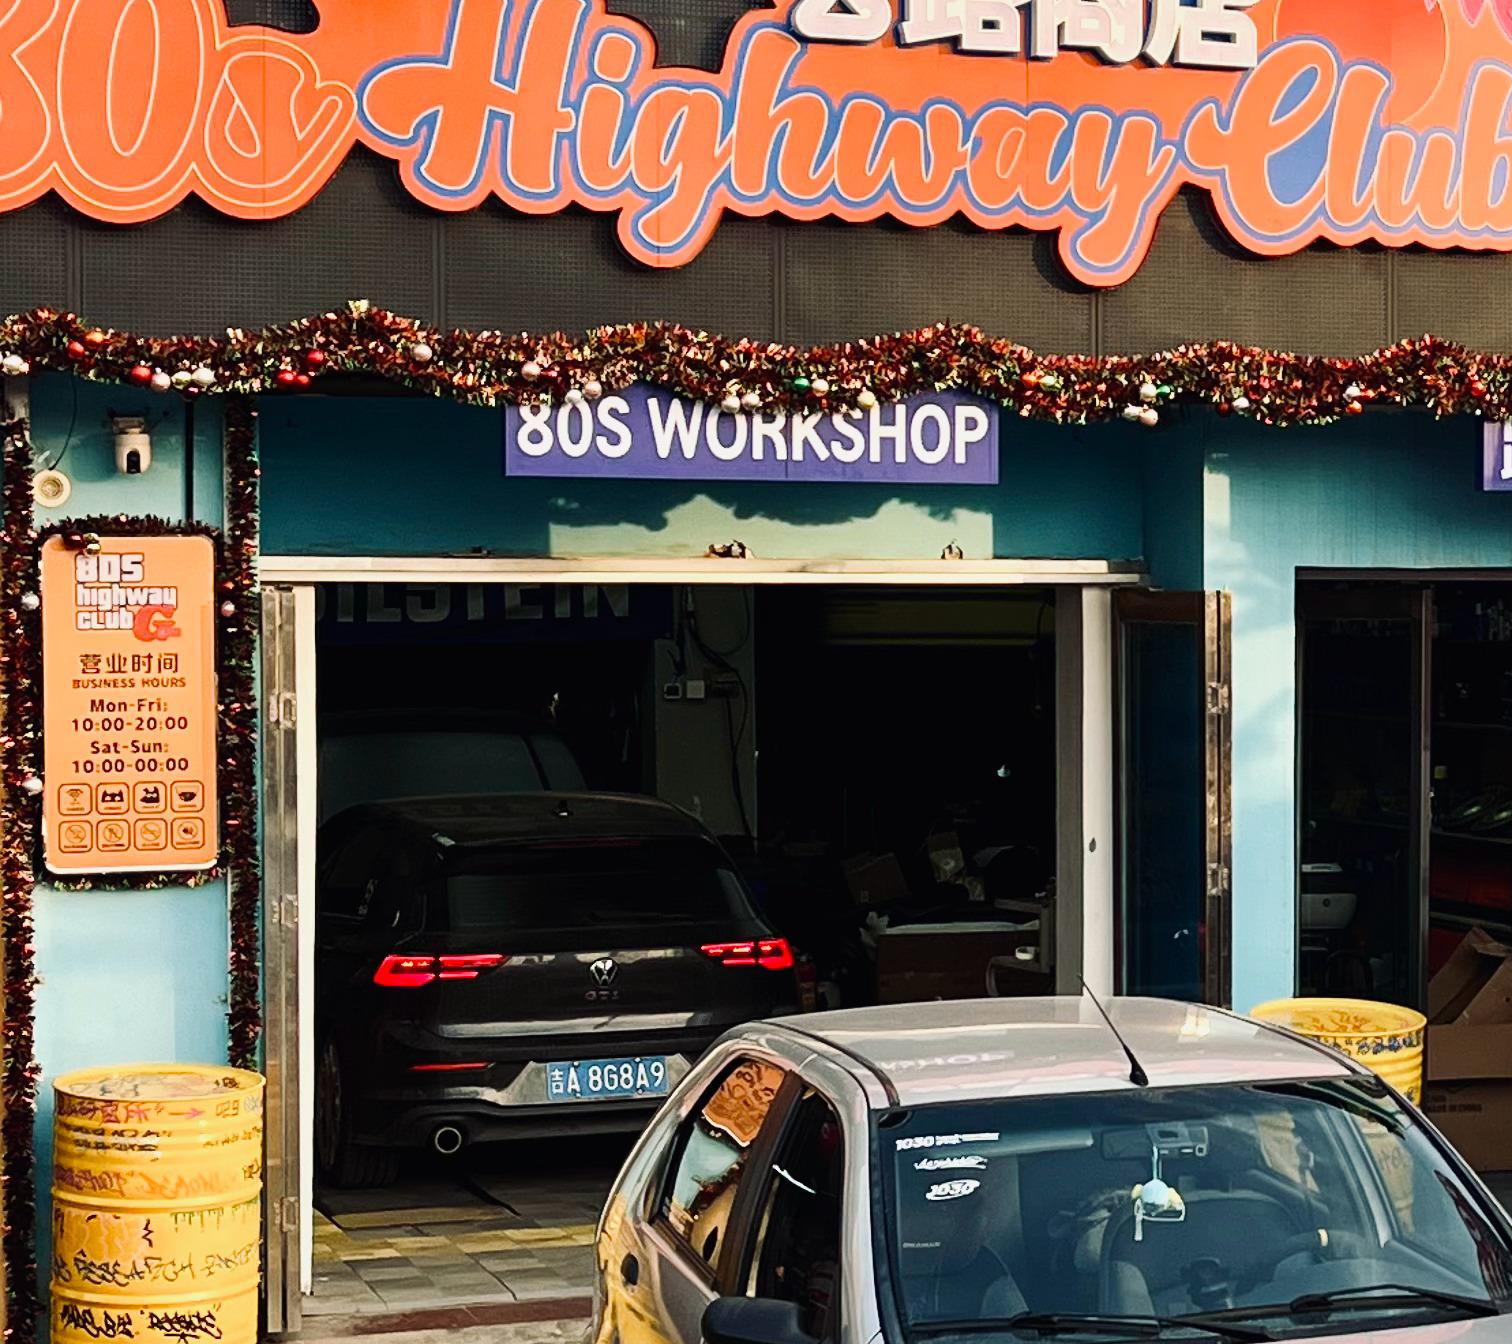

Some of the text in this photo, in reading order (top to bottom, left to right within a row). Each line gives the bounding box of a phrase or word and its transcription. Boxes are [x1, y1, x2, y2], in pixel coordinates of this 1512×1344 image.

[515, 395, 989, 464] 80S WORKSHOP
[76, 553, 144, 583] 80S
[76, 582, 178, 611] highway
[316, 584, 630, 623] ILSTEIN
[79, 653, 178, 674] 营业时间
[72, 676, 187, 690] BUSINESS HOURS
[89, 698, 169, 714] Mon-Fri:
[71, 715, 189, 733] 10:00-20:00
[90, 739, 170, 756] Sat-Sun:
[72, 758, 189, 774] 10:00-00:00
